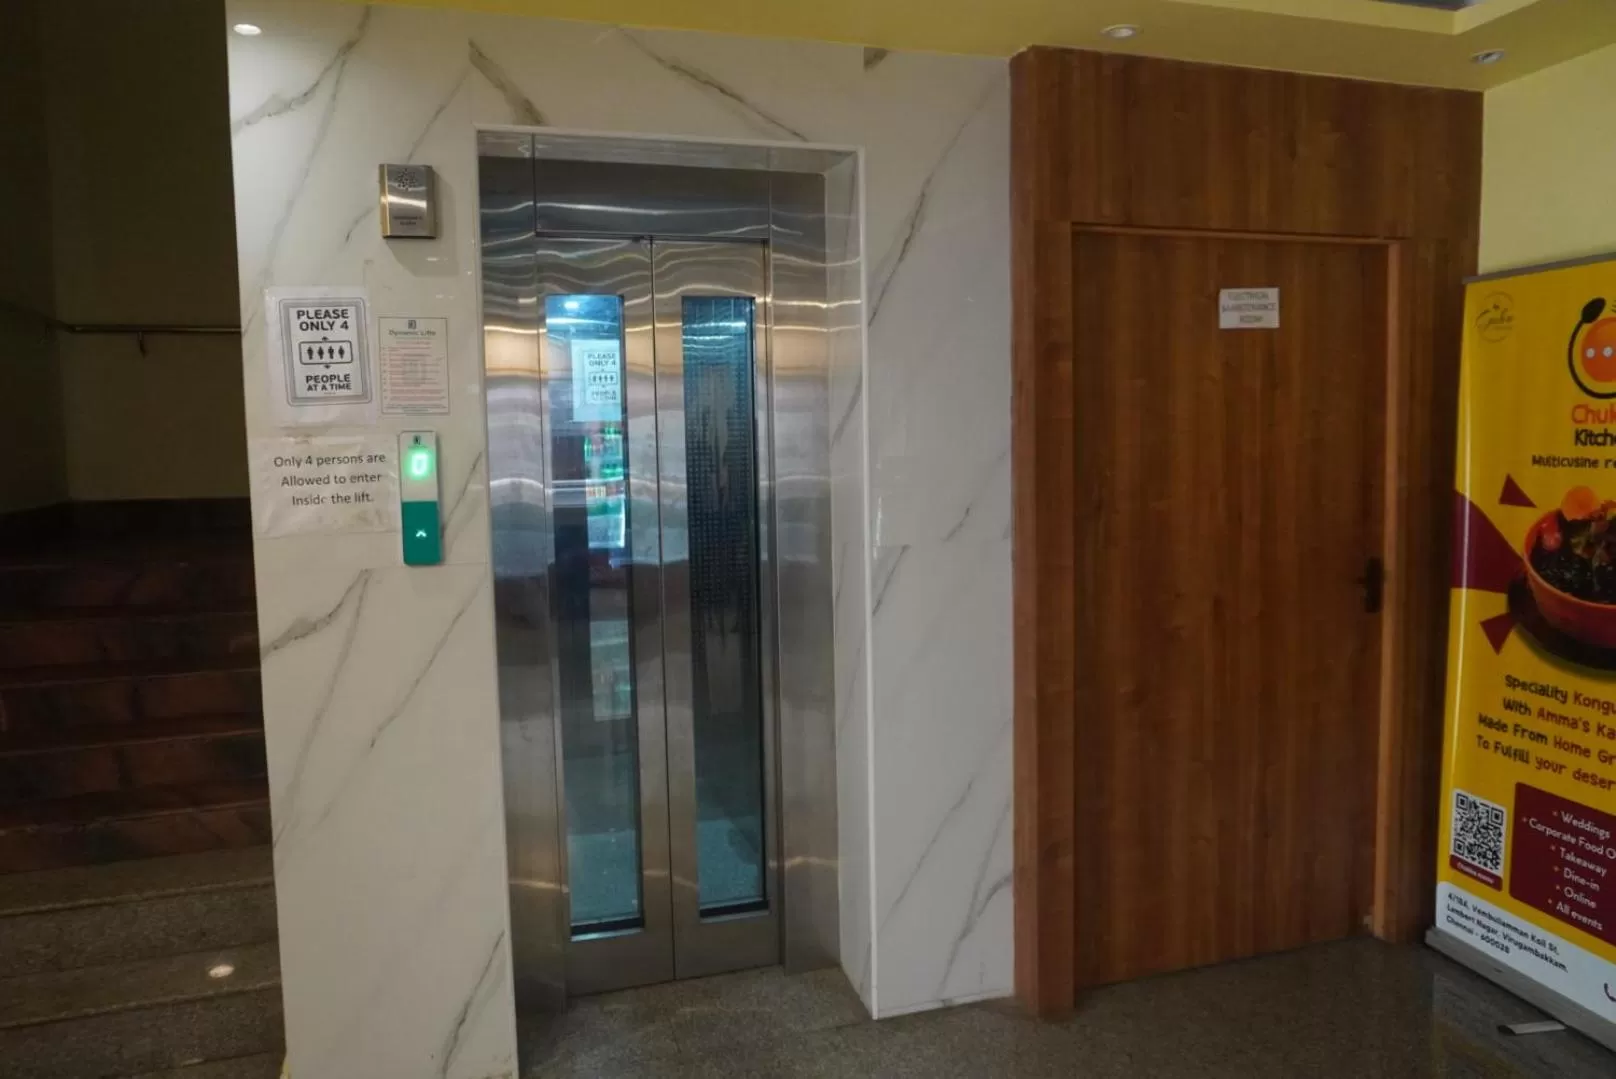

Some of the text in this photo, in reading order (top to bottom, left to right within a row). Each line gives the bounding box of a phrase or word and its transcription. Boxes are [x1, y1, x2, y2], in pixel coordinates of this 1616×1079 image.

[296, 308, 350, 320] PLEASE
[299, 320, 349, 332] ONLY 4
[305, 373, 351, 384] PEOPLE
[306, 384, 319, 392] AT
[329, 383, 352, 391] TIME
[273, 453, 387, 469] Only 4 persons are
[281, 472, 383, 487] Allowed to enter
[331, 492, 351, 504] the
[1504, 674, 1568, 704] Speciality
[1502, 697, 1532, 717] With
[1537, 707, 1591, 733] Amma's
[1478, 713, 1616, 766] Made From Home Gr
[1476, 734, 1490, 751] To
[1493, 741, 1530, 764] Fulfill
[1534, 756, 1568, 776] your
[1528, 817, 1578, 845] Corporate
[1578, 838, 1604, 856] Food
[1560, 810, 1611, 841] Weddings
[1559, 847, 1608, 877] Takeaway
[1563, 866, 1600, 892] Dine-in
[1563, 886, 1597, 909] Online
[1556, 901, 1604, 932] All events
